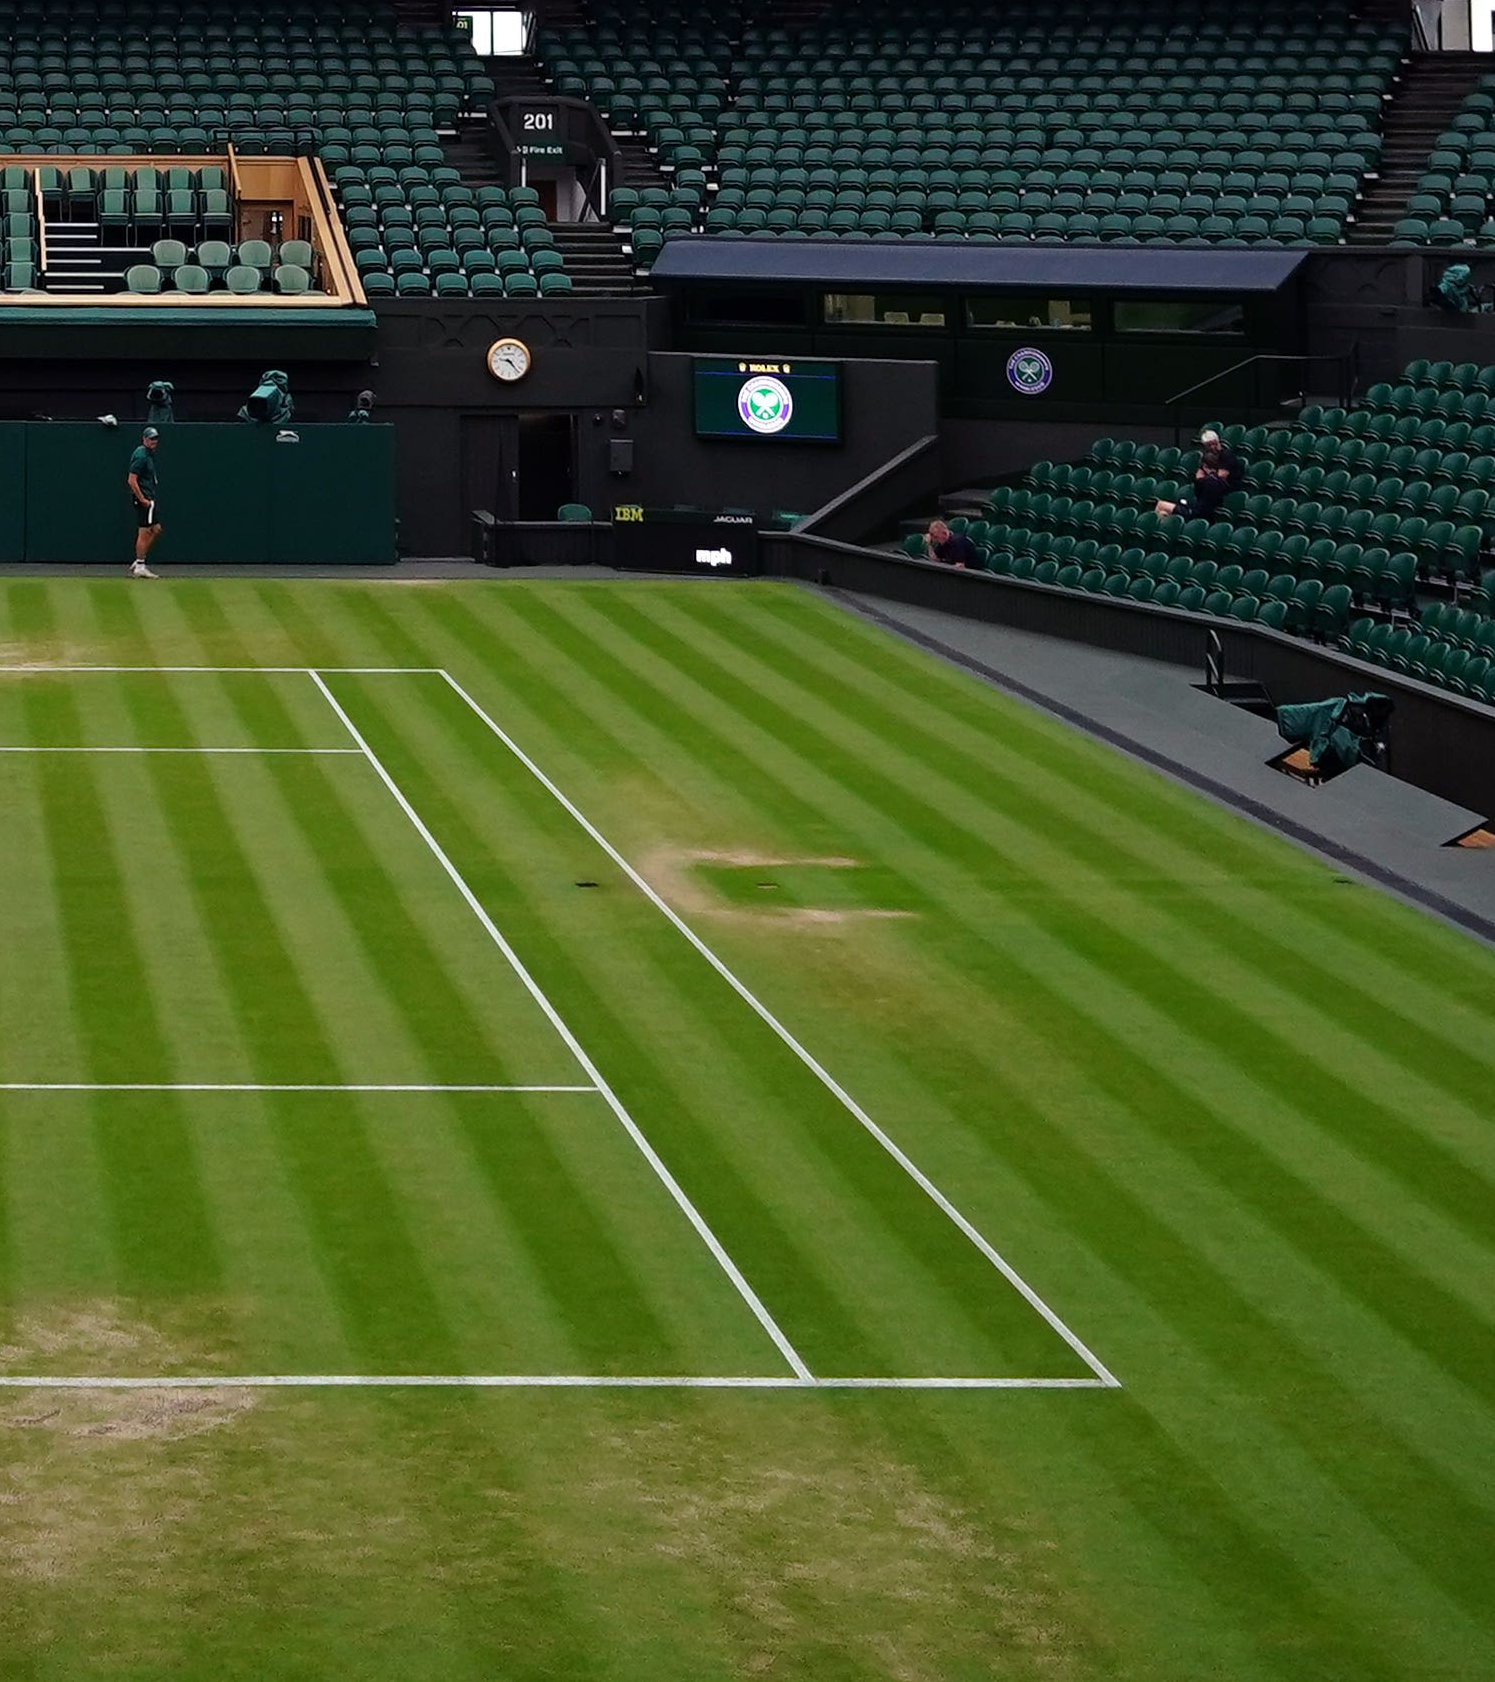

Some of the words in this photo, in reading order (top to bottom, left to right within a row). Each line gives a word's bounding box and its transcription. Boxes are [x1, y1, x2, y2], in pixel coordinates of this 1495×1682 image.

[523, 113, 553, 130] 201
[615, 507, 644, 523] IBM
[713, 515, 753, 524] JAGUAR
[695, 547, 733, 567] mph
